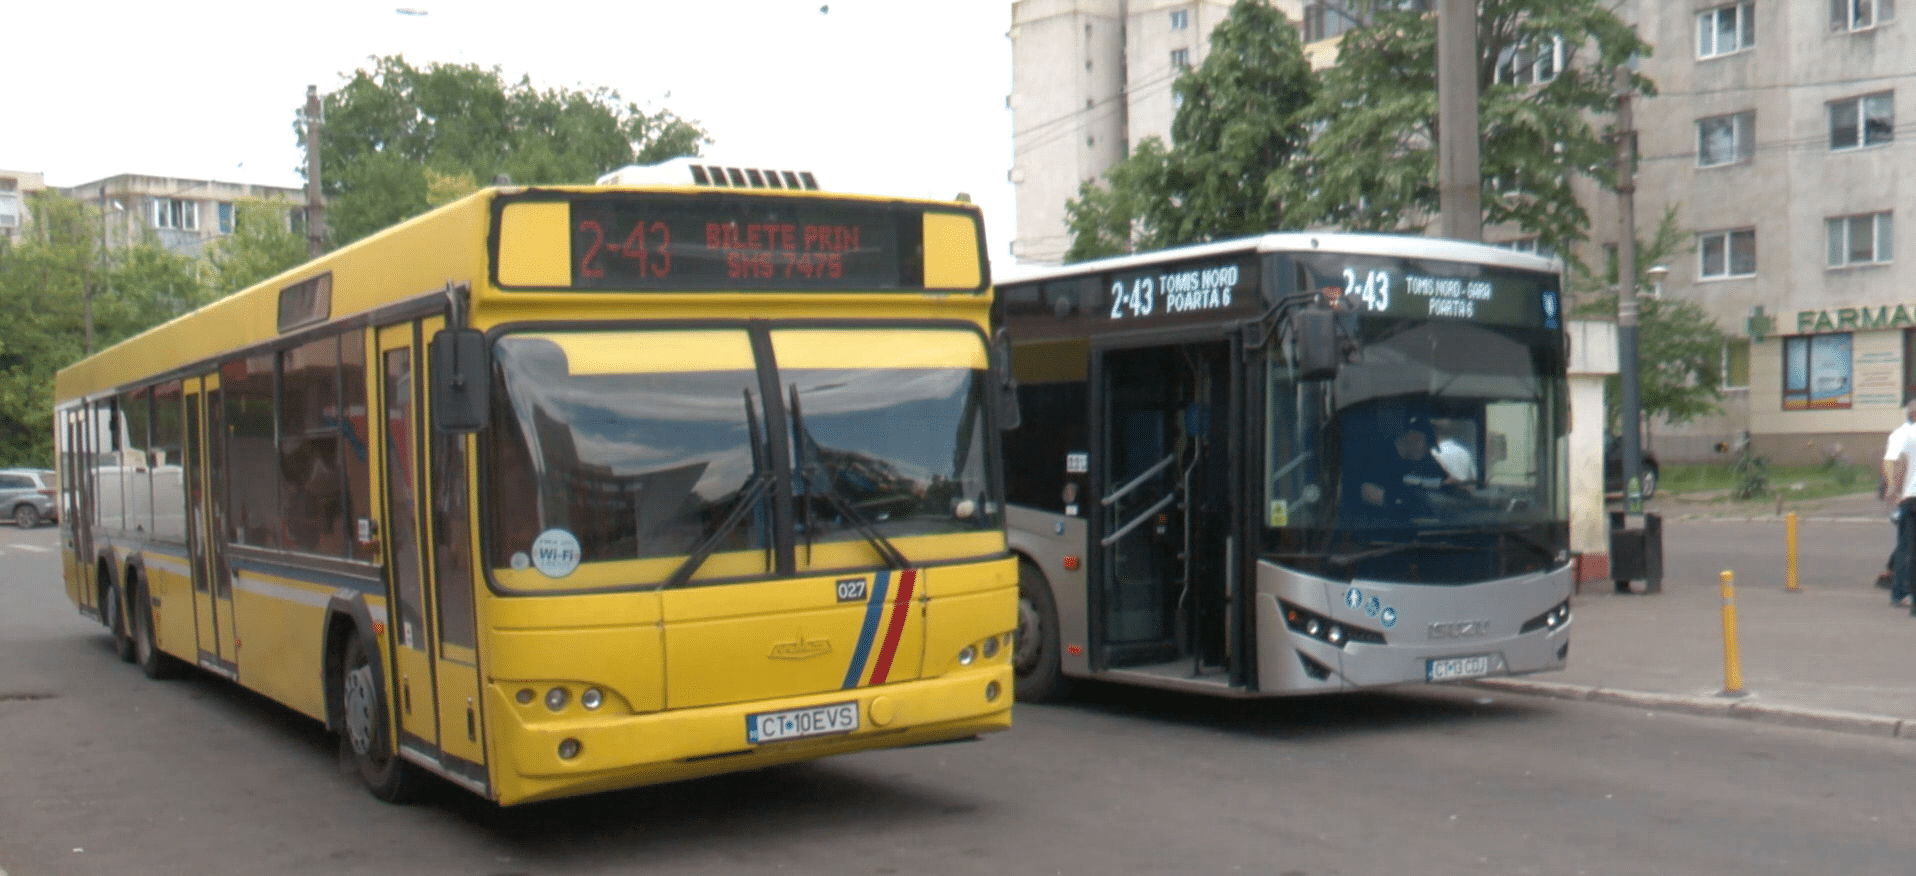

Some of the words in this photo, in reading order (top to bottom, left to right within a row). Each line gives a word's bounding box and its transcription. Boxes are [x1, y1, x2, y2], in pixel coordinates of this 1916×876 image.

[579, 220, 670, 278] 2-43
[706, 223, 795, 250] BILETE
[804, 224, 861, 252] PRIN
[726, 251, 774, 279] SMS
[1159, 271, 1200, 295] TOMIS
[1202, 265, 1239, 289] NORD
[1343, 268, 1391, 312] 2-43
[1405, 274, 1434, 296] TOMIS
[1110, 278, 1154, 319] 2-43
[1166, 288, 1220, 313] POARTA
[1222, 286, 1232, 307] 6
[1428, 297, 1465, 316] POARTA
[1466, 299, 1475, 319] 6
[1797, 303, 1916, 332] FARMA
[838, 580, 866, 599] 027
[762, 716, 786, 738] CT
